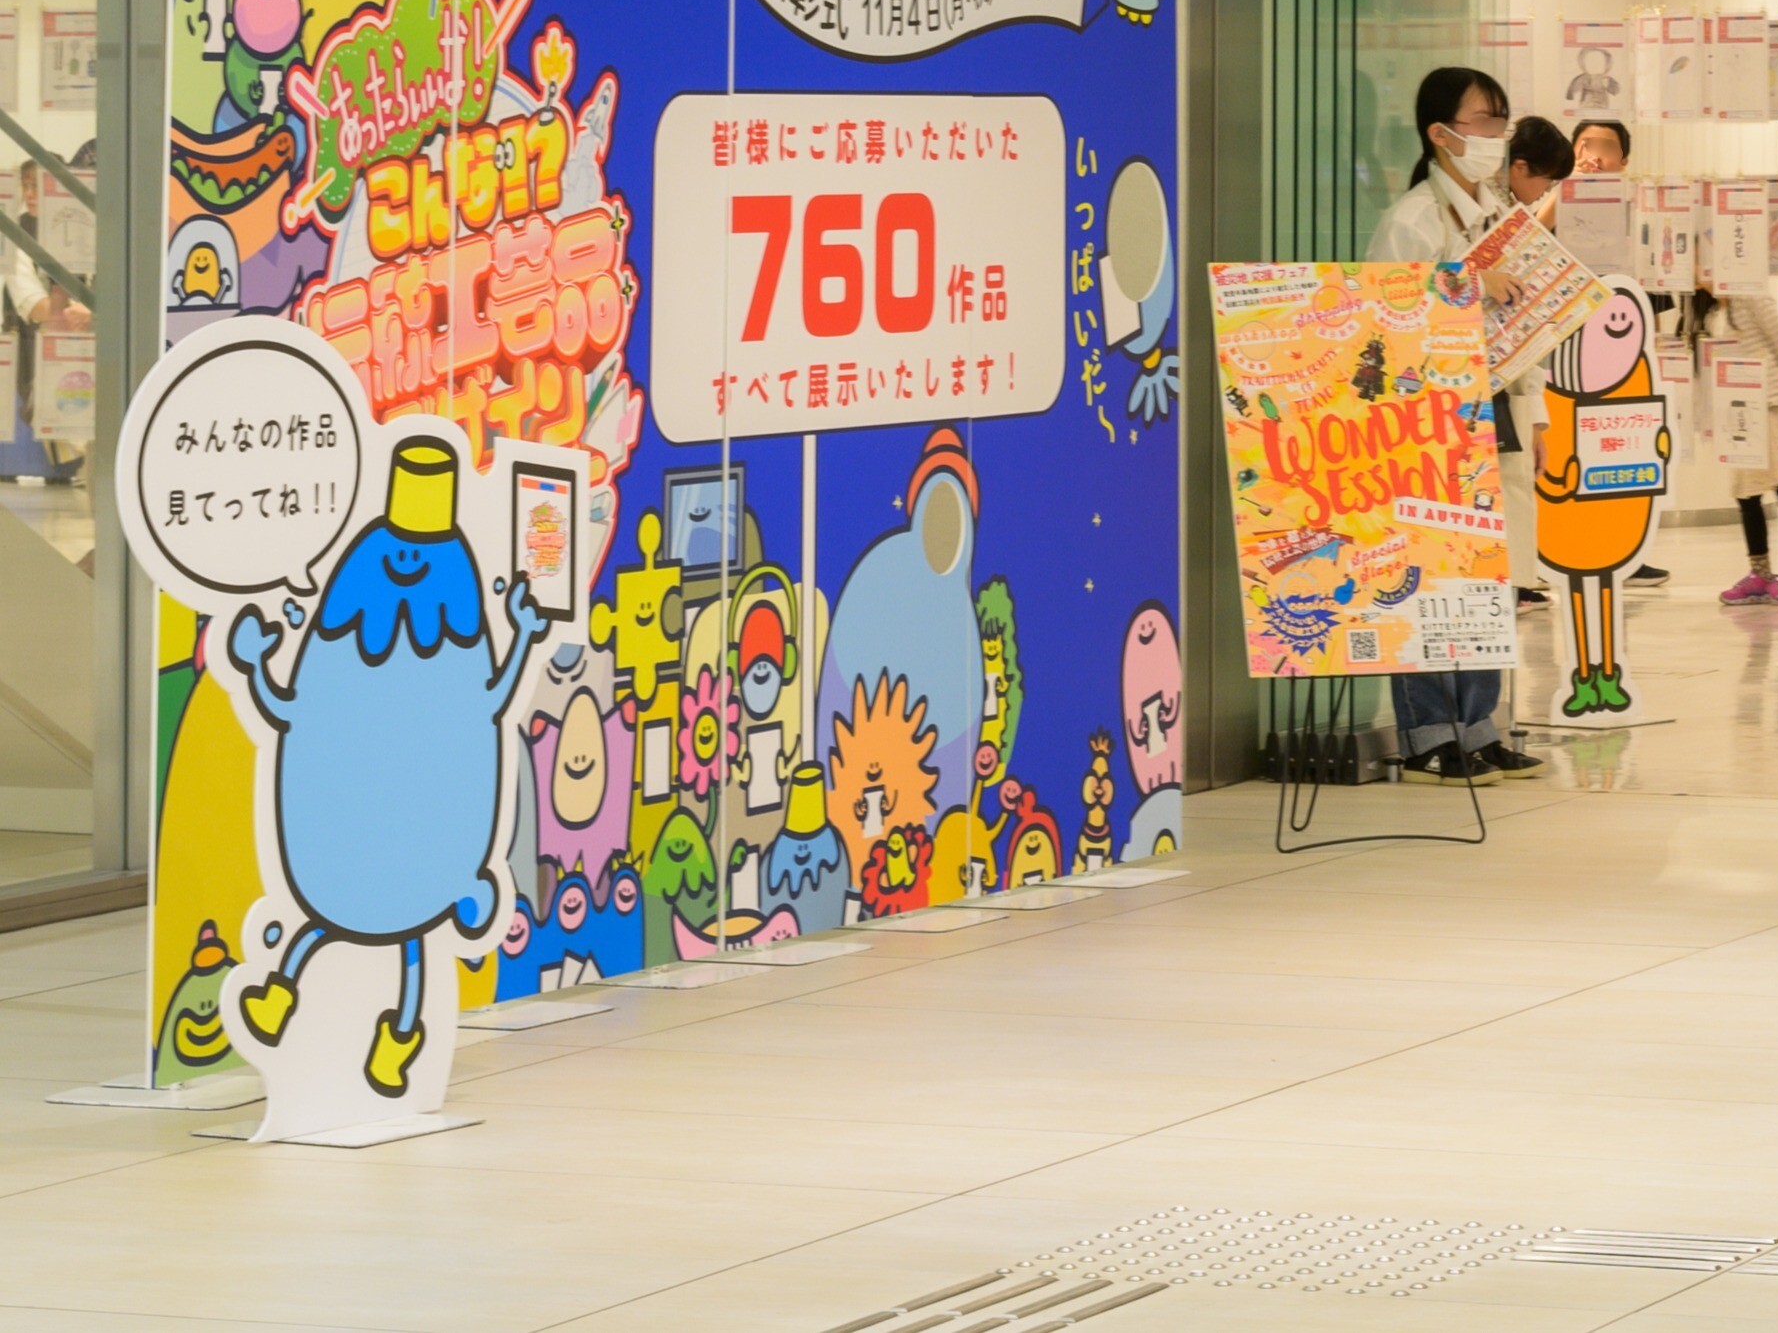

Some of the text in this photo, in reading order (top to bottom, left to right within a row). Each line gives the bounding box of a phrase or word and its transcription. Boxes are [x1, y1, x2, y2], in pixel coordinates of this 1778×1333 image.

[328, 1, 487, 163] あったらいいな!
[712, 120, 1019, 167] 皆様にご応募いただいた
[730, 192, 1008, 342] 760 作品
[381, 359, 586, 473] ザイン
[712, 353, 1016, 416] すべて展示いたします!
[175, 412, 338, 455] みんなの作品
[1262, 389, 1472, 484] WONDER
[165, 480, 339, 528] 見てってね!!
[1302, 449, 1464, 528] SESSION
[1399, 503, 1504, 532] IN AUTUMN
